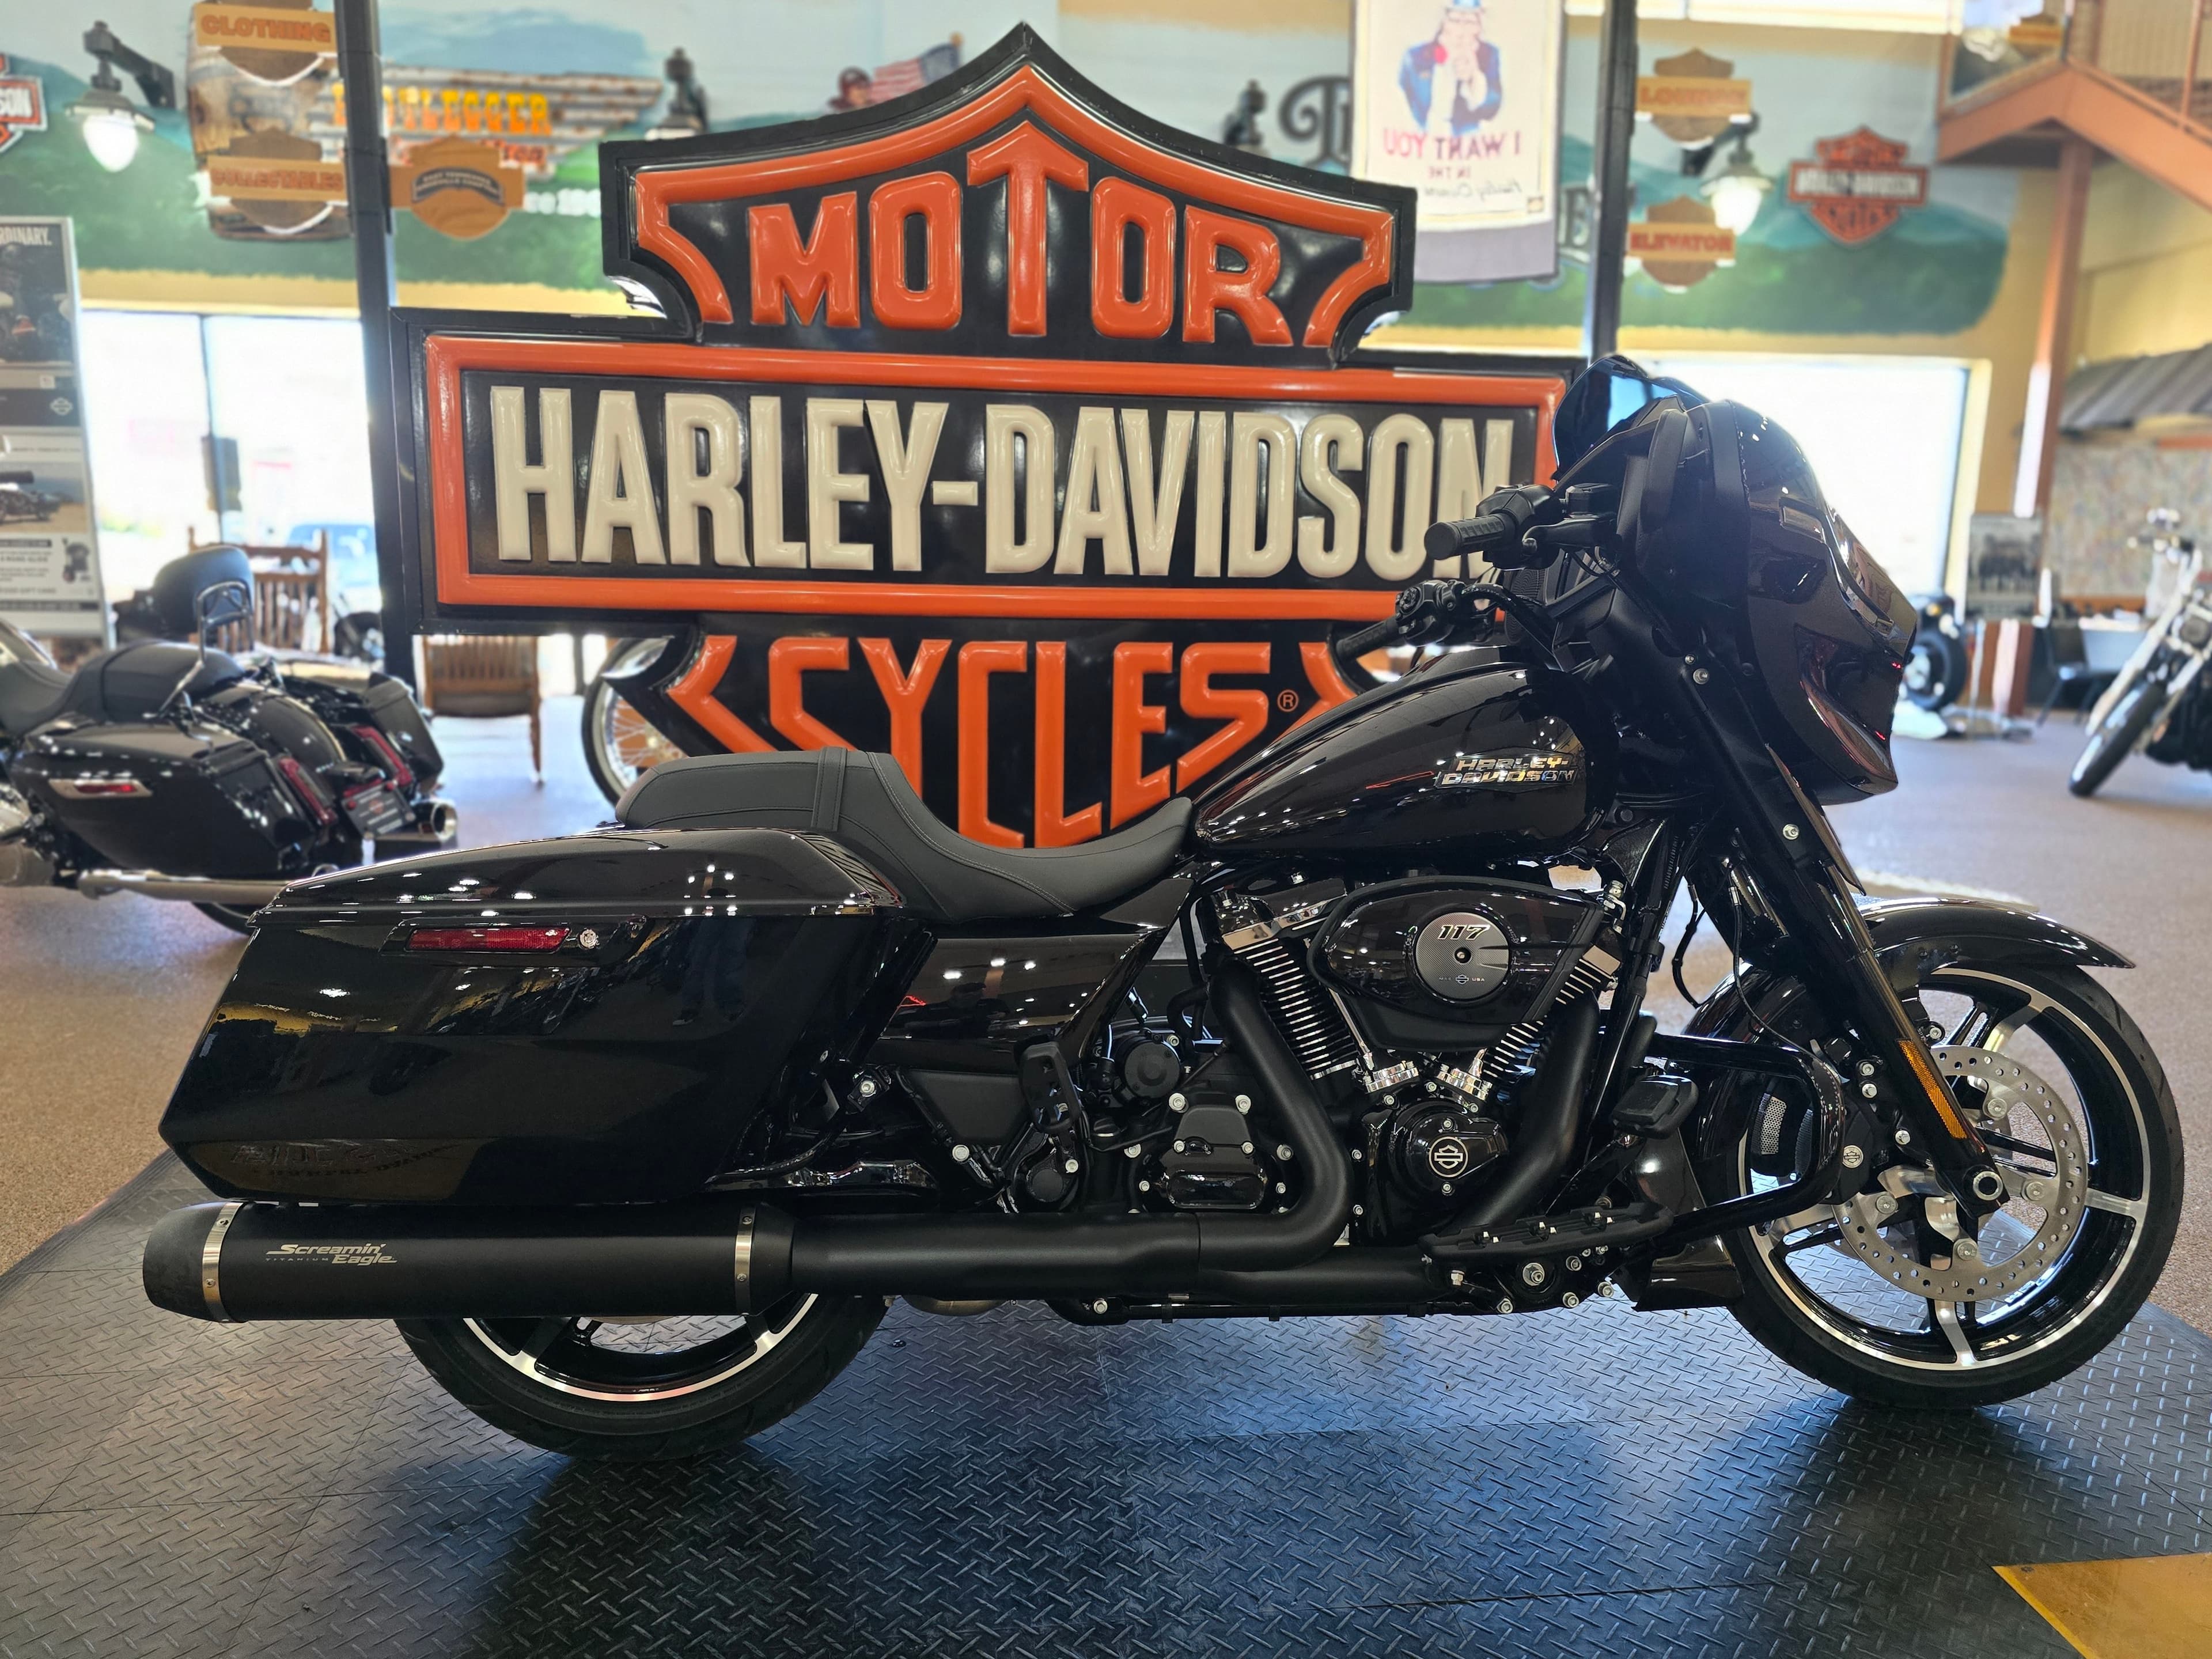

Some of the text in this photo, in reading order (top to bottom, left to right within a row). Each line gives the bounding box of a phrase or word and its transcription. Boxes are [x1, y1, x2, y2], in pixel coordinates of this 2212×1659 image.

[201, 14, 331, 43] CLOTHING
[748, 119, 1293, 346] MOTOR
[490, 385, 1515, 581] HARLEY-DAVIDSON
[768, 638, 1271, 849] CYCLES
[1455, 757, 1569, 772] HARLEY-
[1441, 769, 1574, 785] DAVIDSON
[1438, 923, 1491, 940] 117
[266, 1243, 387, 1255] Screamin'
[331, 1252, 398, 1266] Eagle
